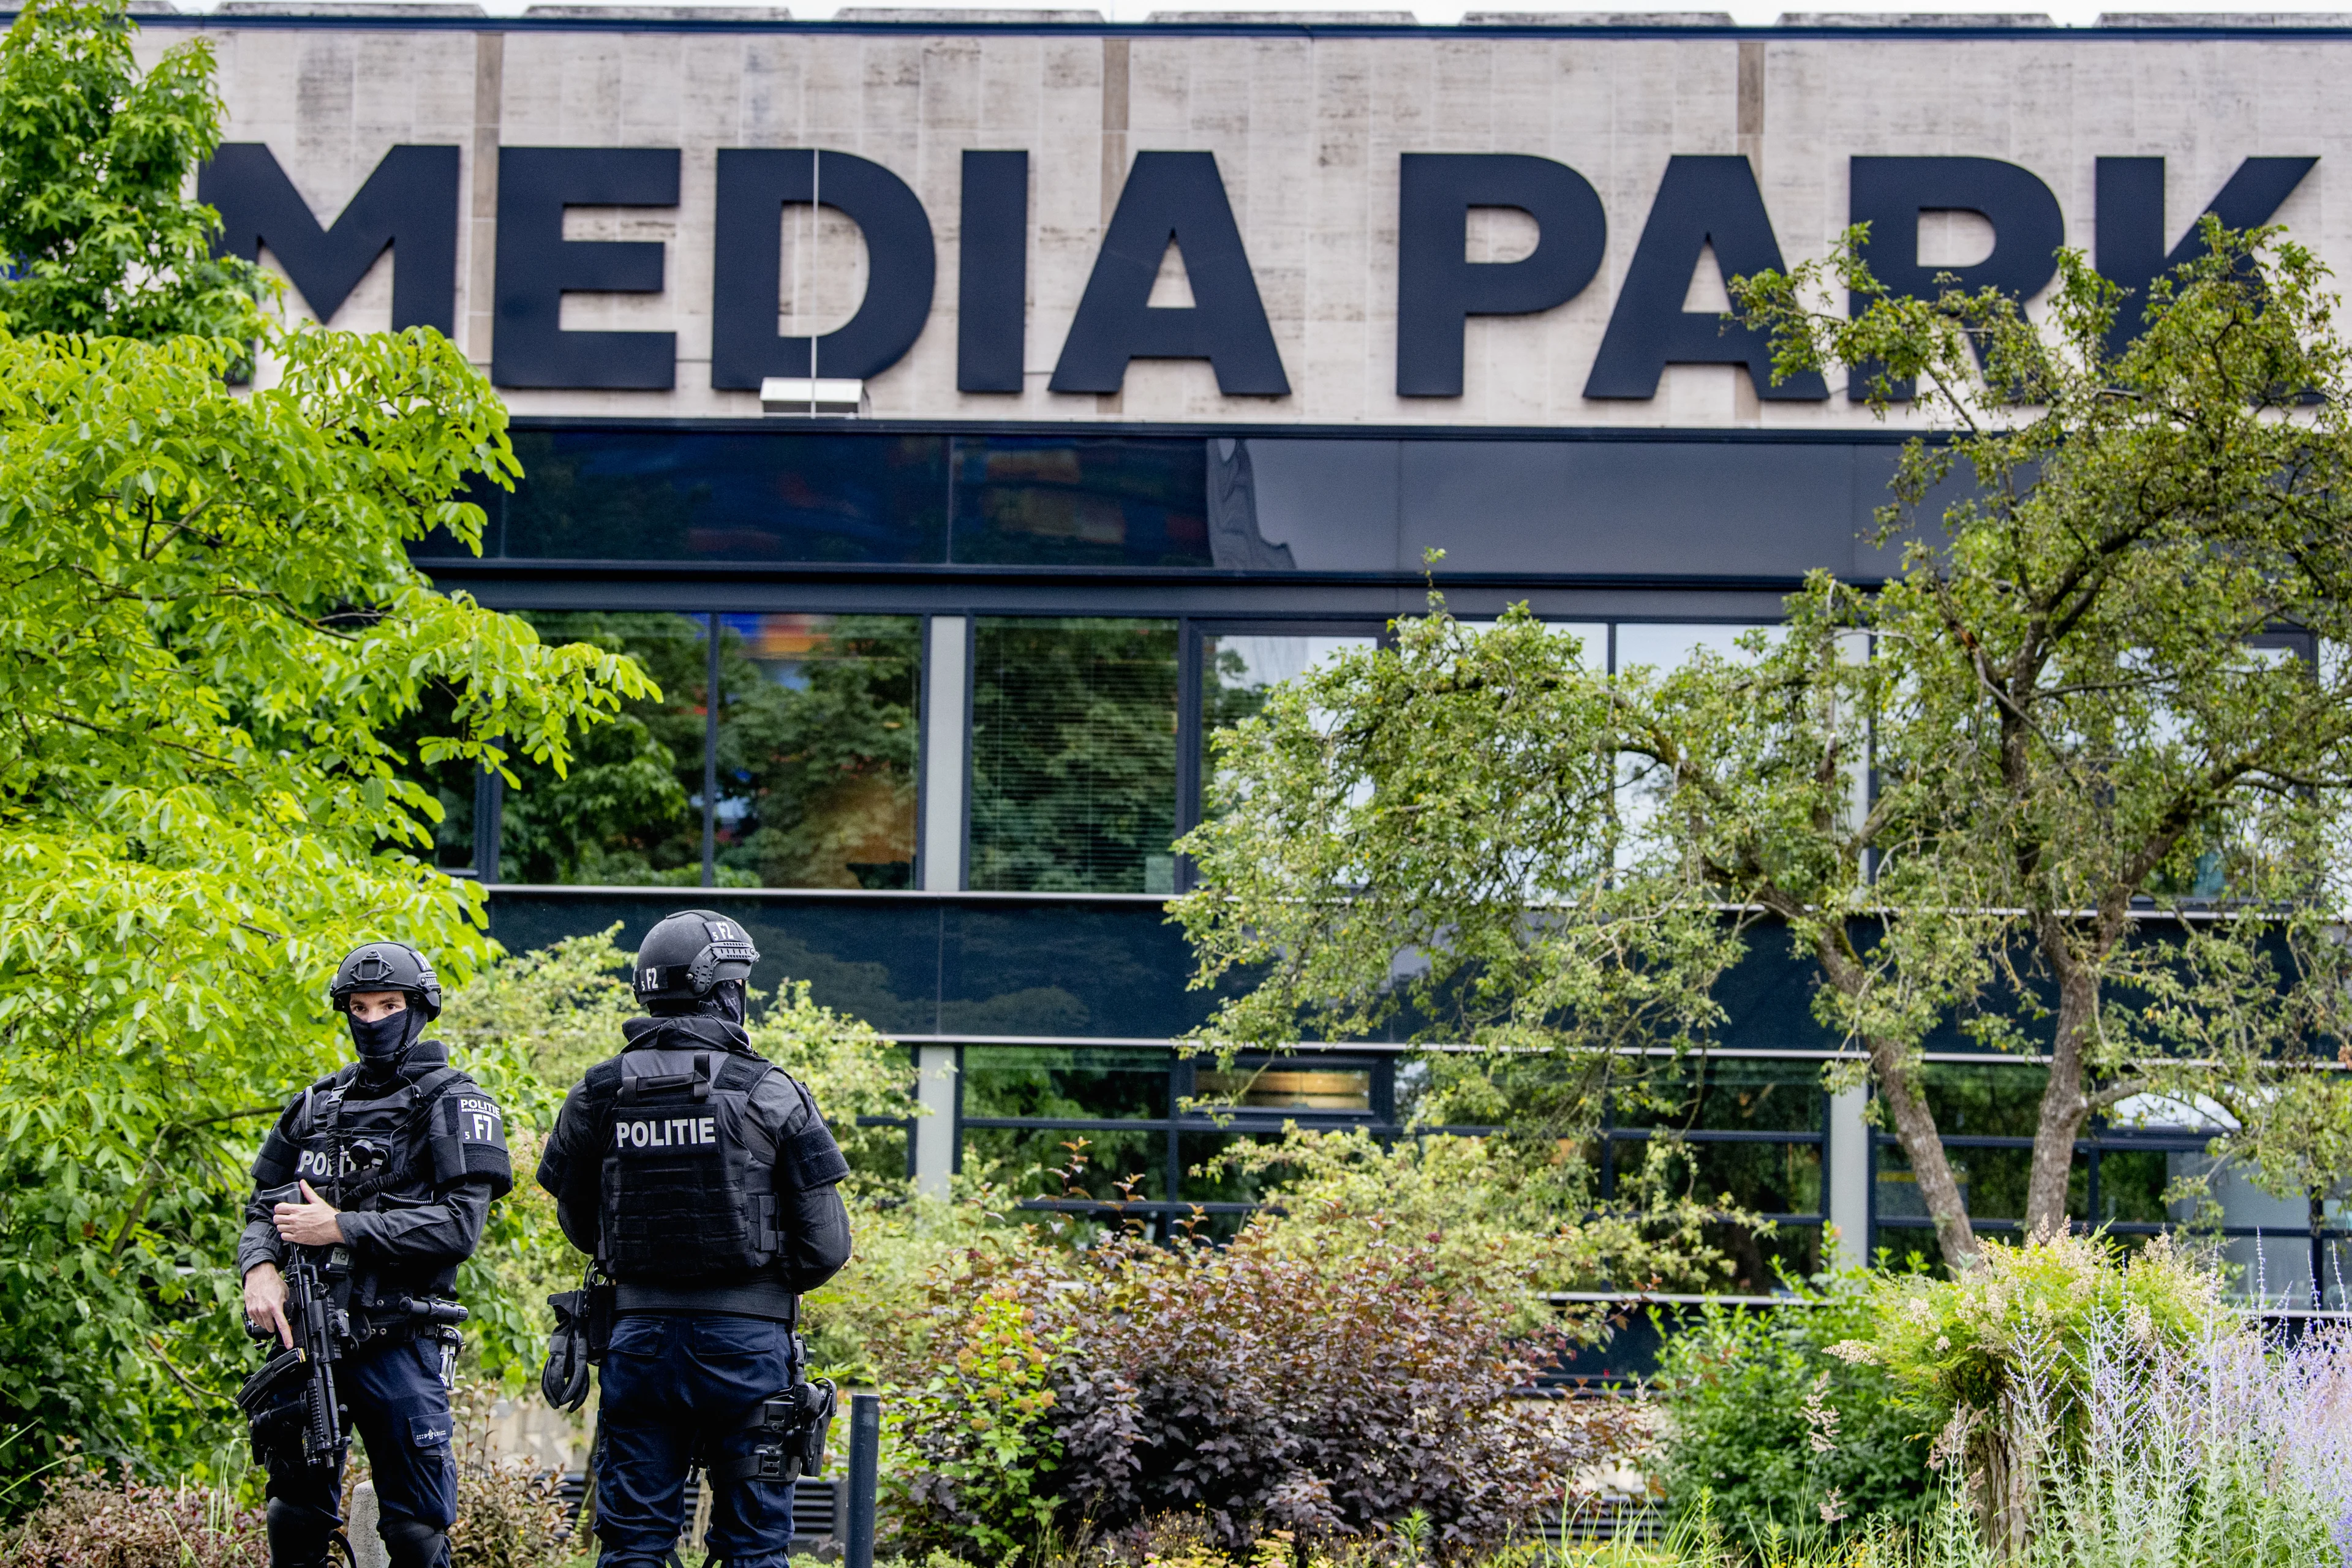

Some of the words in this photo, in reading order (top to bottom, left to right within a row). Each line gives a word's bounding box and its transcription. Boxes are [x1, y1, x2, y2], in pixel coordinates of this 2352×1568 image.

[197, 143, 1291, 396] MEDIA
[1396, 153, 2329, 404] PARK
[712, 932, 718, 941] 5
[715, 922, 734, 939] F2
[641, 981, 645, 990] 5
[646, 968, 658, 989] F2
[461, 1099, 500, 1117] POLITIE
[465, 1131, 470, 1140] 5
[473, 1114, 492, 1141] F7
[616, 1117, 715, 1147] POLITIE
[334, 1252, 347, 1261] TQ
